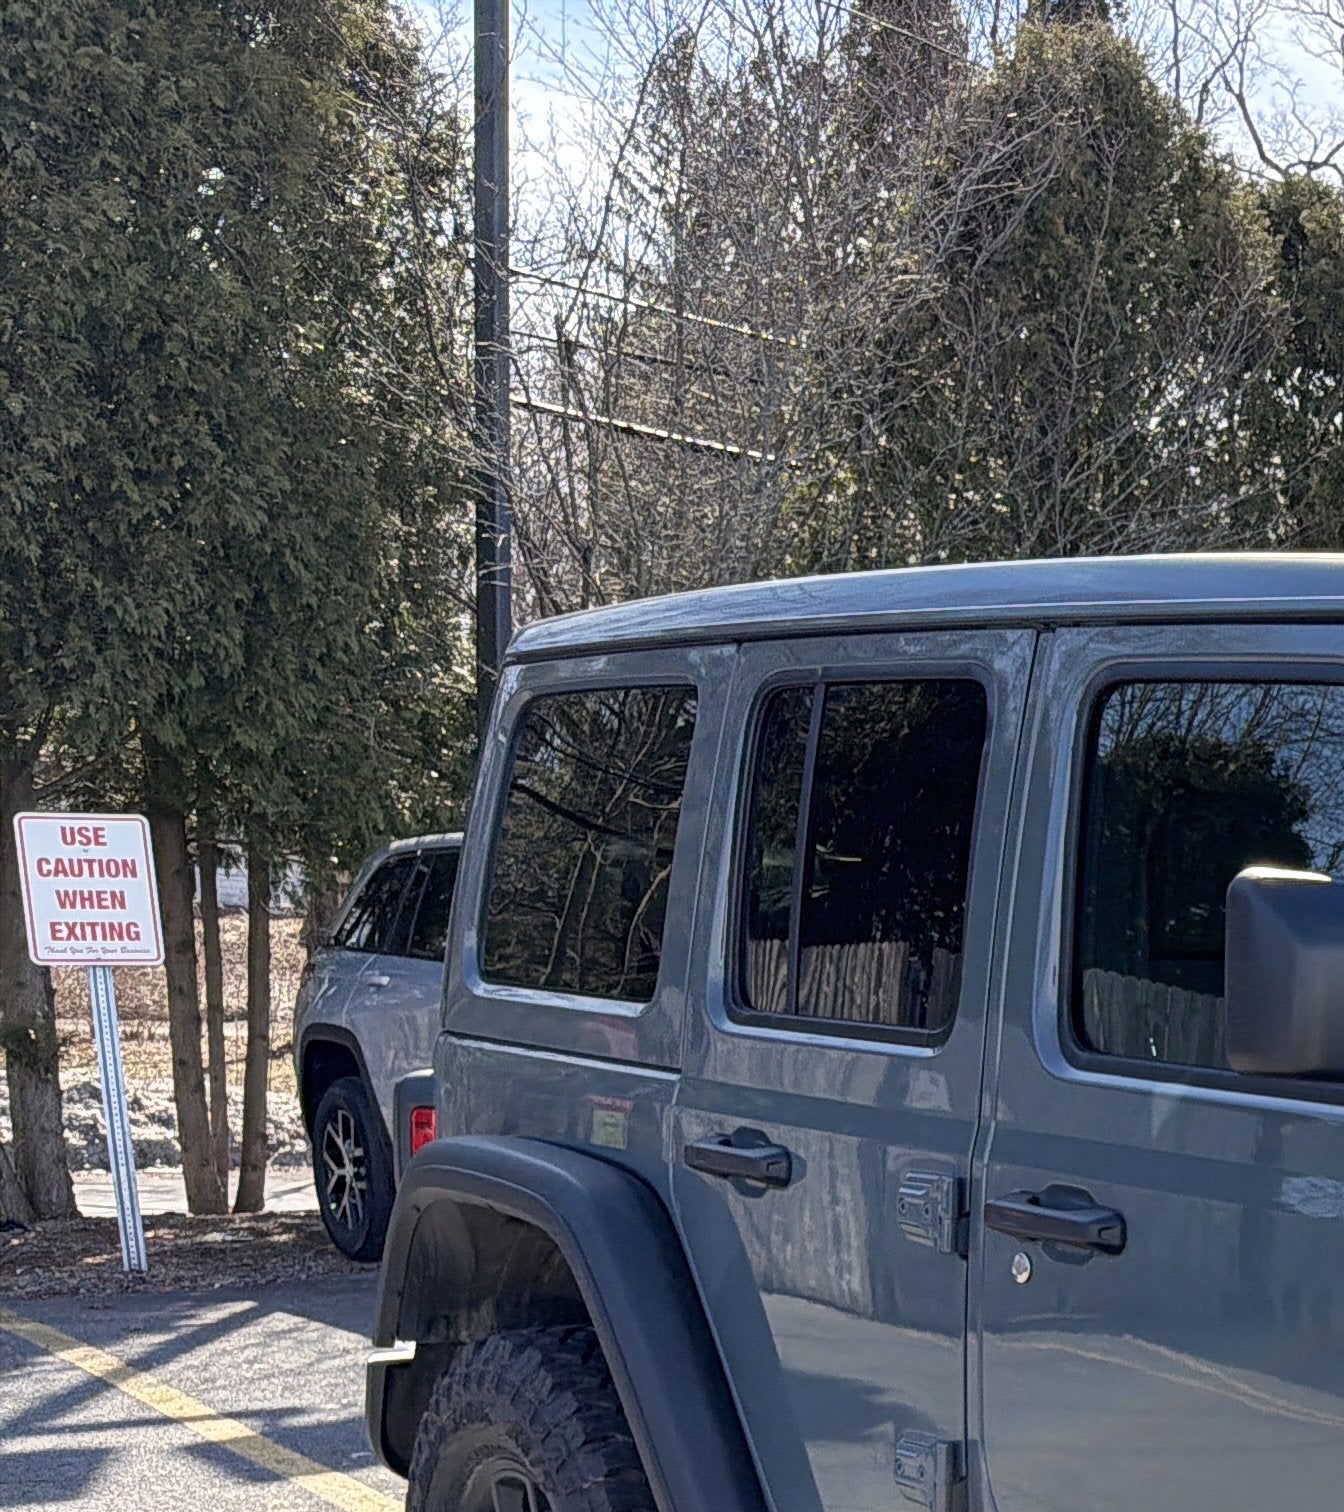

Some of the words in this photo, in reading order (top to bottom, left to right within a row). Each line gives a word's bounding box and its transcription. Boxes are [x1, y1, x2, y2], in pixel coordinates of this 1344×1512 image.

[60, 826, 107, 847] USE
[36, 858, 138, 878] CAUTION
[55, 889, 127, 910] WHEN
[49, 921, 141, 942] EXITING
